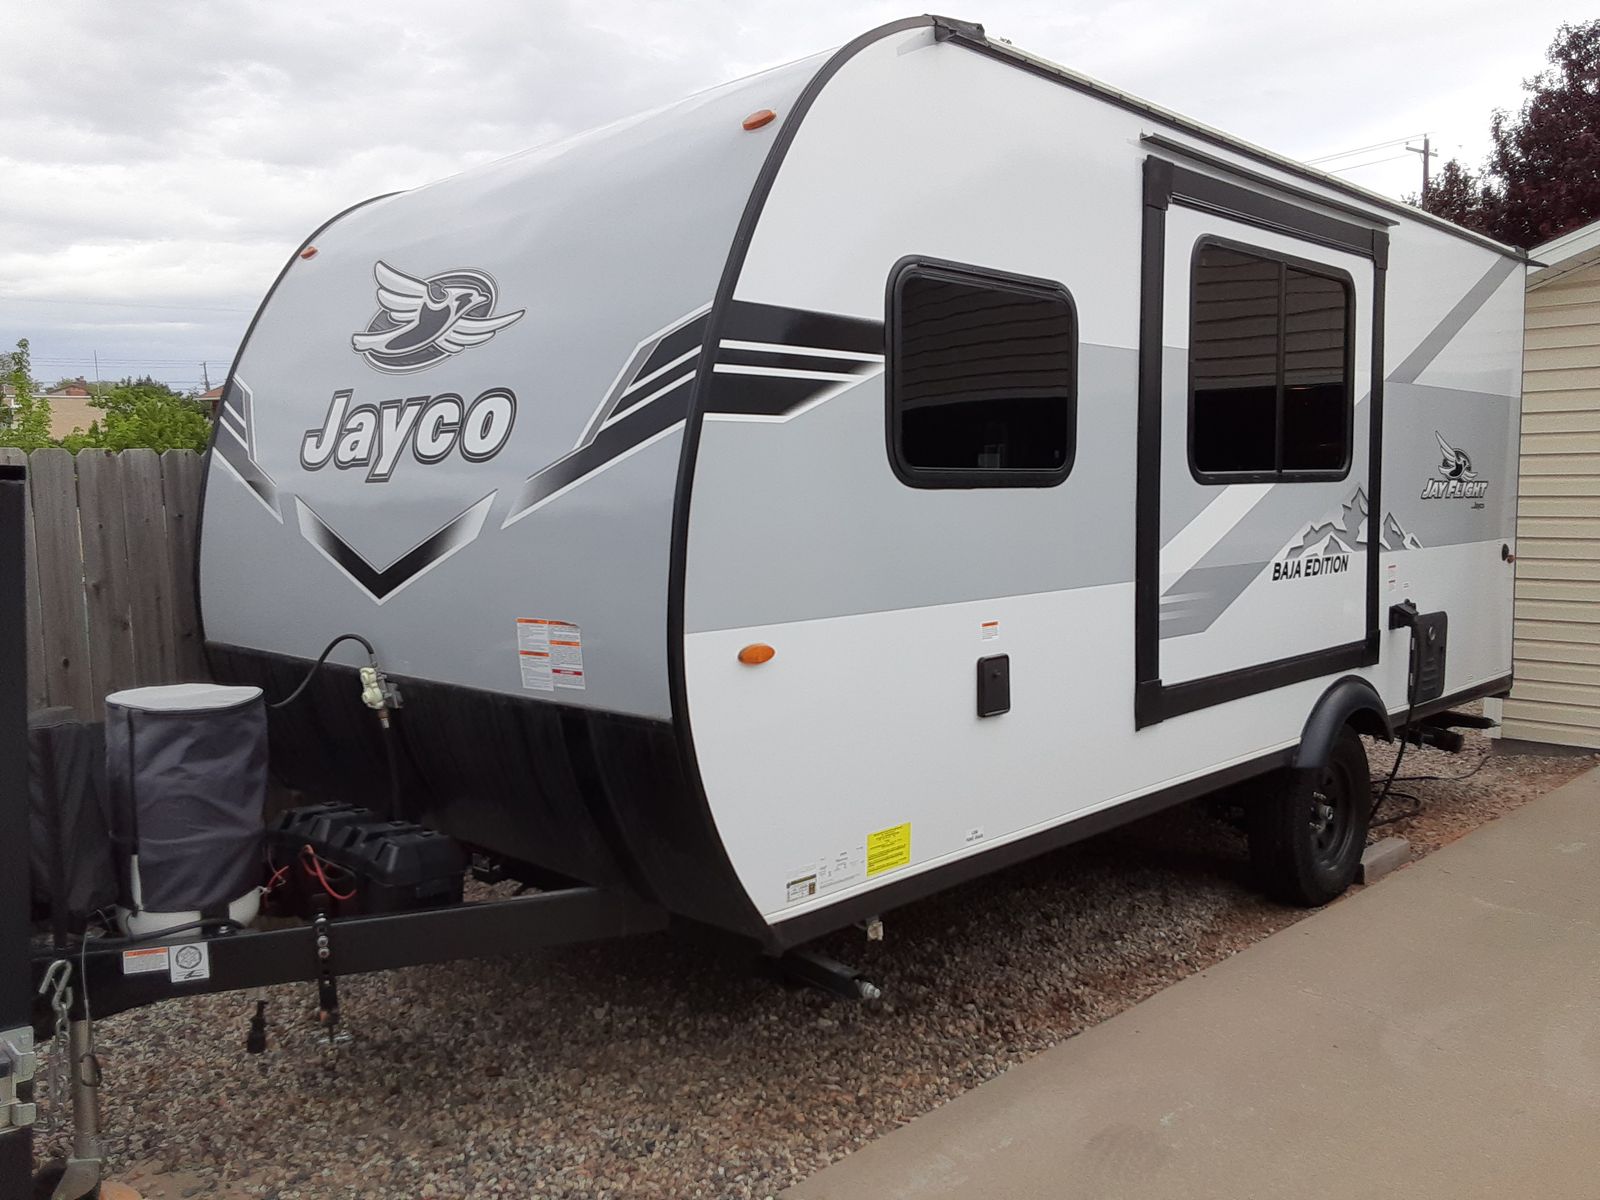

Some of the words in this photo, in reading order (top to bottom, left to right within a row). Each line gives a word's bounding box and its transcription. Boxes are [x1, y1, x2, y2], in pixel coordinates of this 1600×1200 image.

[301, 388, 517, 483] Jayco
[1421, 478, 1447, 499] JAY
[1445, 479, 1488, 499] FLIGHT
[1272, 560, 1301, 581] BAJA
[1304, 555, 1349, 577] EDITION
